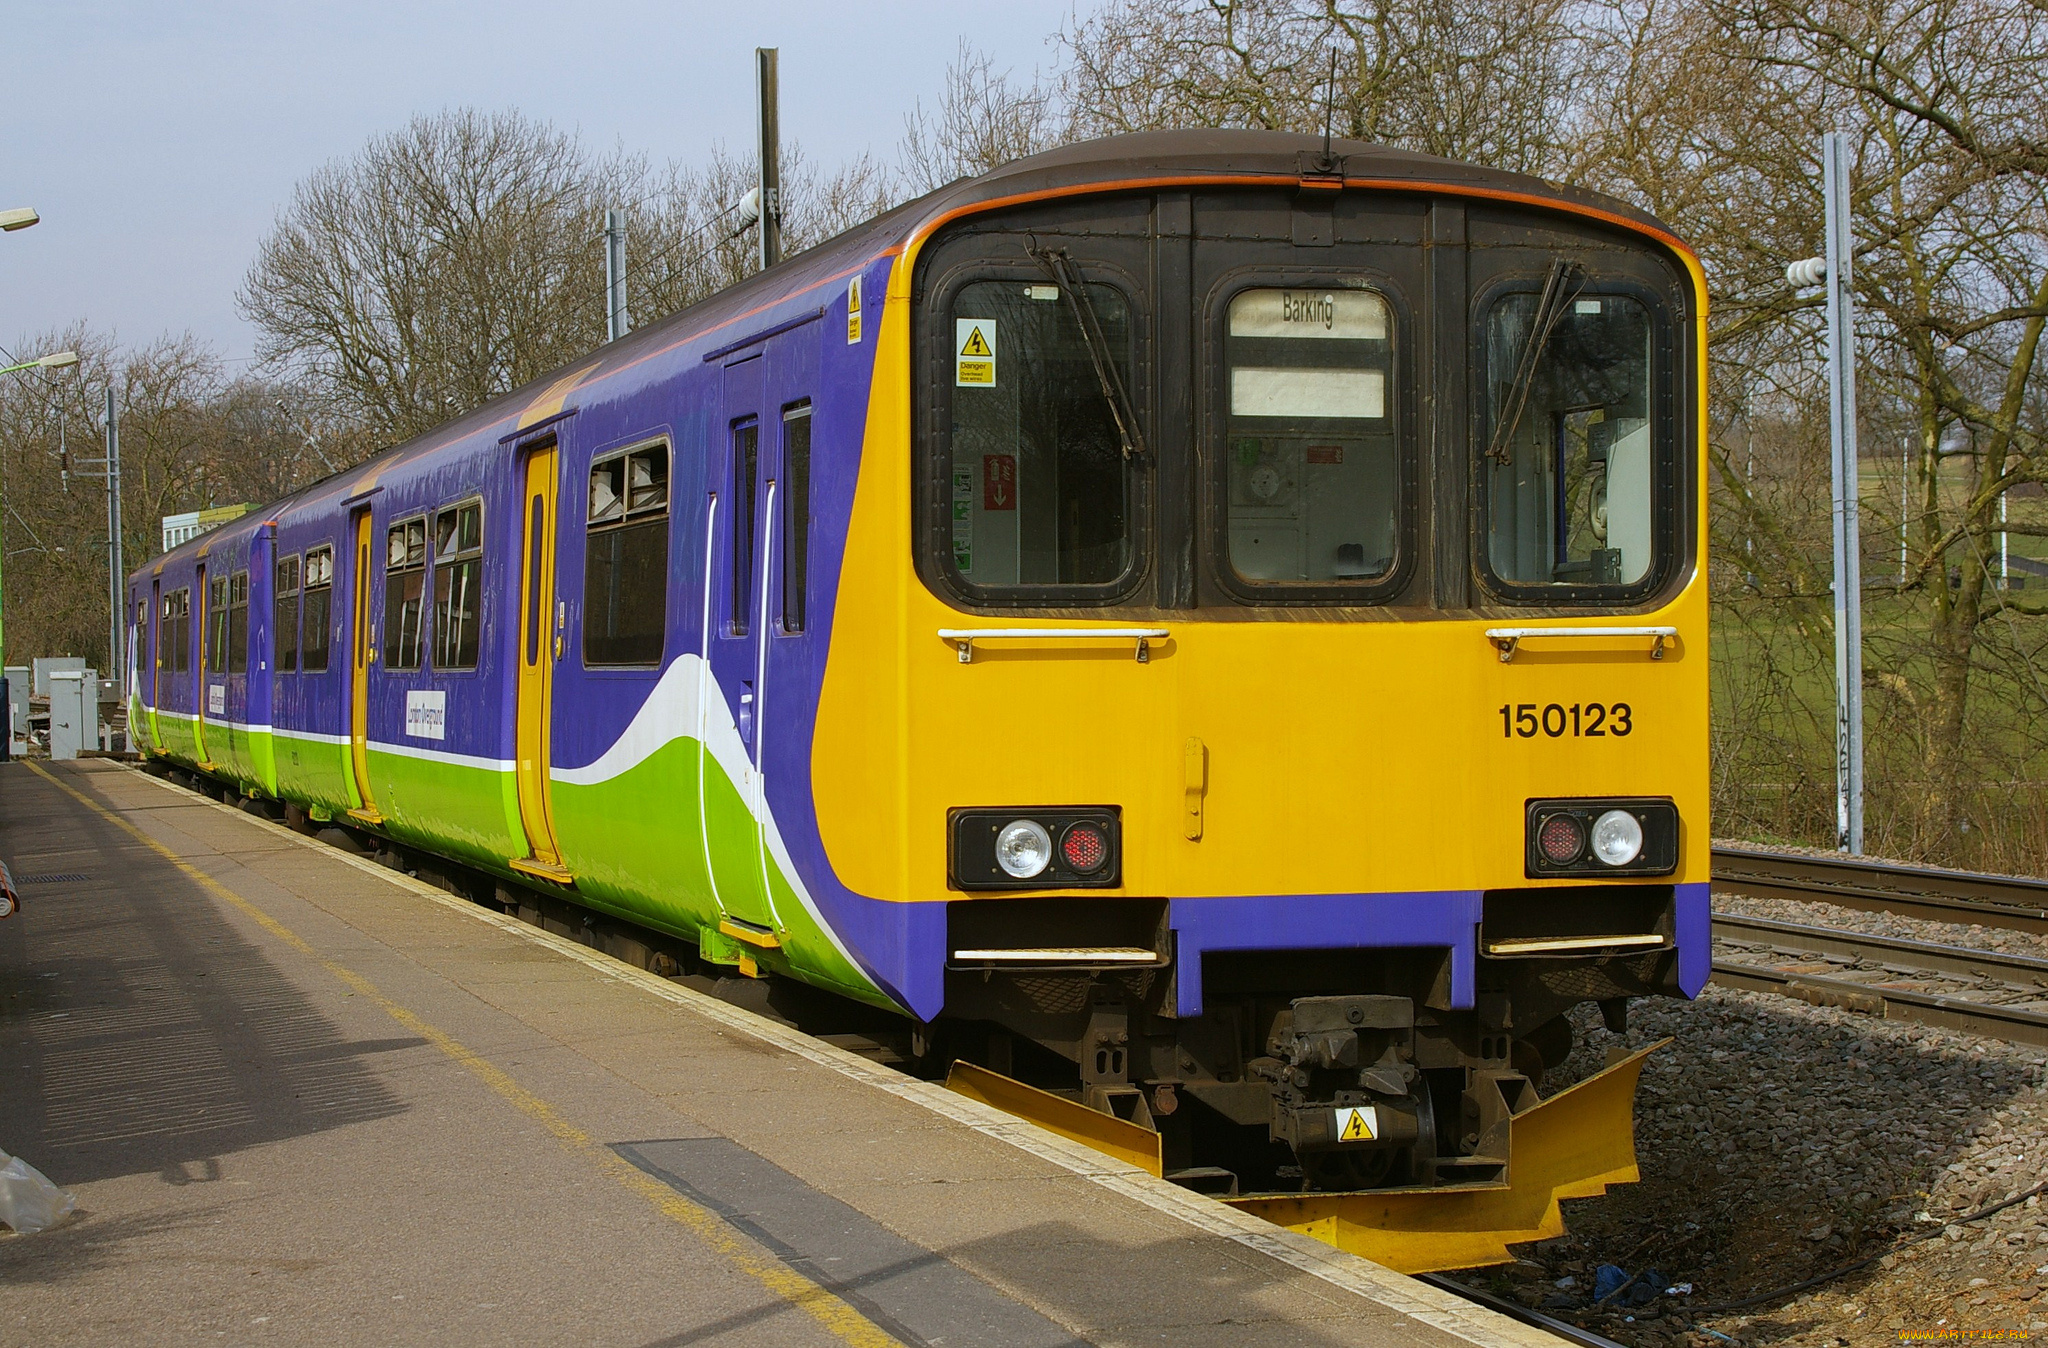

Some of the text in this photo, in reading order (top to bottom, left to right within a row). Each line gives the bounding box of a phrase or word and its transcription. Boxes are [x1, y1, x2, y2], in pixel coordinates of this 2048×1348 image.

[1283, 292, 1333, 330] Barking
[961, 362, 986, 370] Danger
[1498, 702, 1633, 738] 150123
